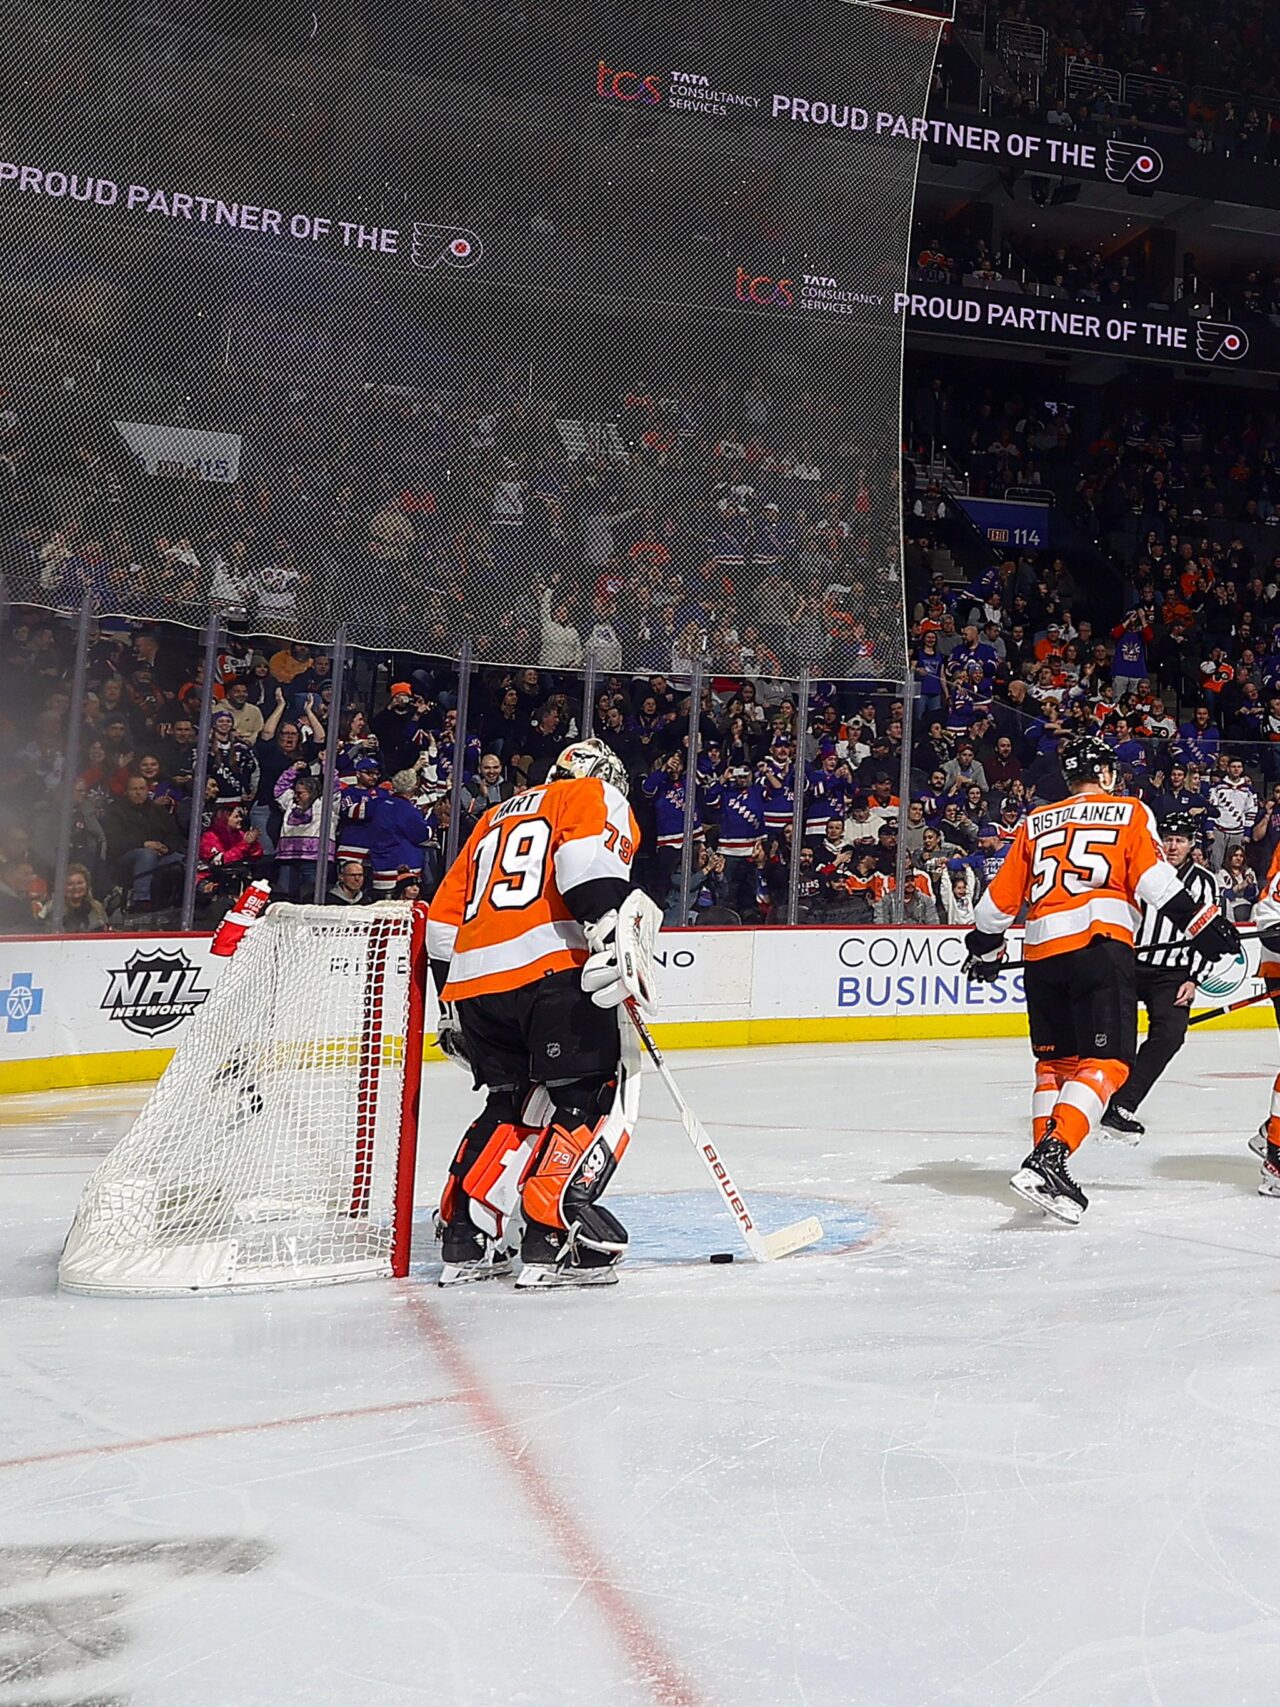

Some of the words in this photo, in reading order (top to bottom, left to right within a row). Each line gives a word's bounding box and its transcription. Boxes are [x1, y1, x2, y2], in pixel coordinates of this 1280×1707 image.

[597, 60, 661, 104] tcs
[670, 71, 709, 86] TATA
[669, 85, 761, 109] CONSULTANCY
[669, 98, 726, 115] SERVICES
[772, 94, 868, 131] PROUD
[876, 112, 1000, 153] PARTNER
[1006, 133, 1041, 158] OF
[1046, 139, 1095, 168] THE
[0, 162, 117, 206] PROUD
[127, 185, 282, 235] PARTNER
[290, 215, 331, 241] OF
[338, 220, 399, 254] THE
[736, 266, 793, 309] tcs
[803, 274, 837, 287] TATA
[800, 299, 853, 314] SERVICES
[801, 286, 883, 306] CONSULTANCY
[894, 291, 980, 322] PROUD
[988, 303, 1100, 337] PARTNER
[1106, 319, 1136, 342] OF
[1142, 323, 1187, 348] THE
[1014, 529, 1040, 546] 114
[1065, 757, 1078, 770] 55
[1032, 805, 1127, 836] RISTOLAINEN
[603, 821, 633, 866] 79
[1030, 828, 1120, 905] 55
[652, 951, 694, 968] NO
[839, 937, 1025, 967] COMCT
[101, 968, 211, 1008] NHL
[838, 975, 1027, 1007] BUSINESS
[111, 1004, 195, 1019] NETWORK
[552, 1150, 571, 1166] 79
[702, 1144, 754, 1233] BAUER
